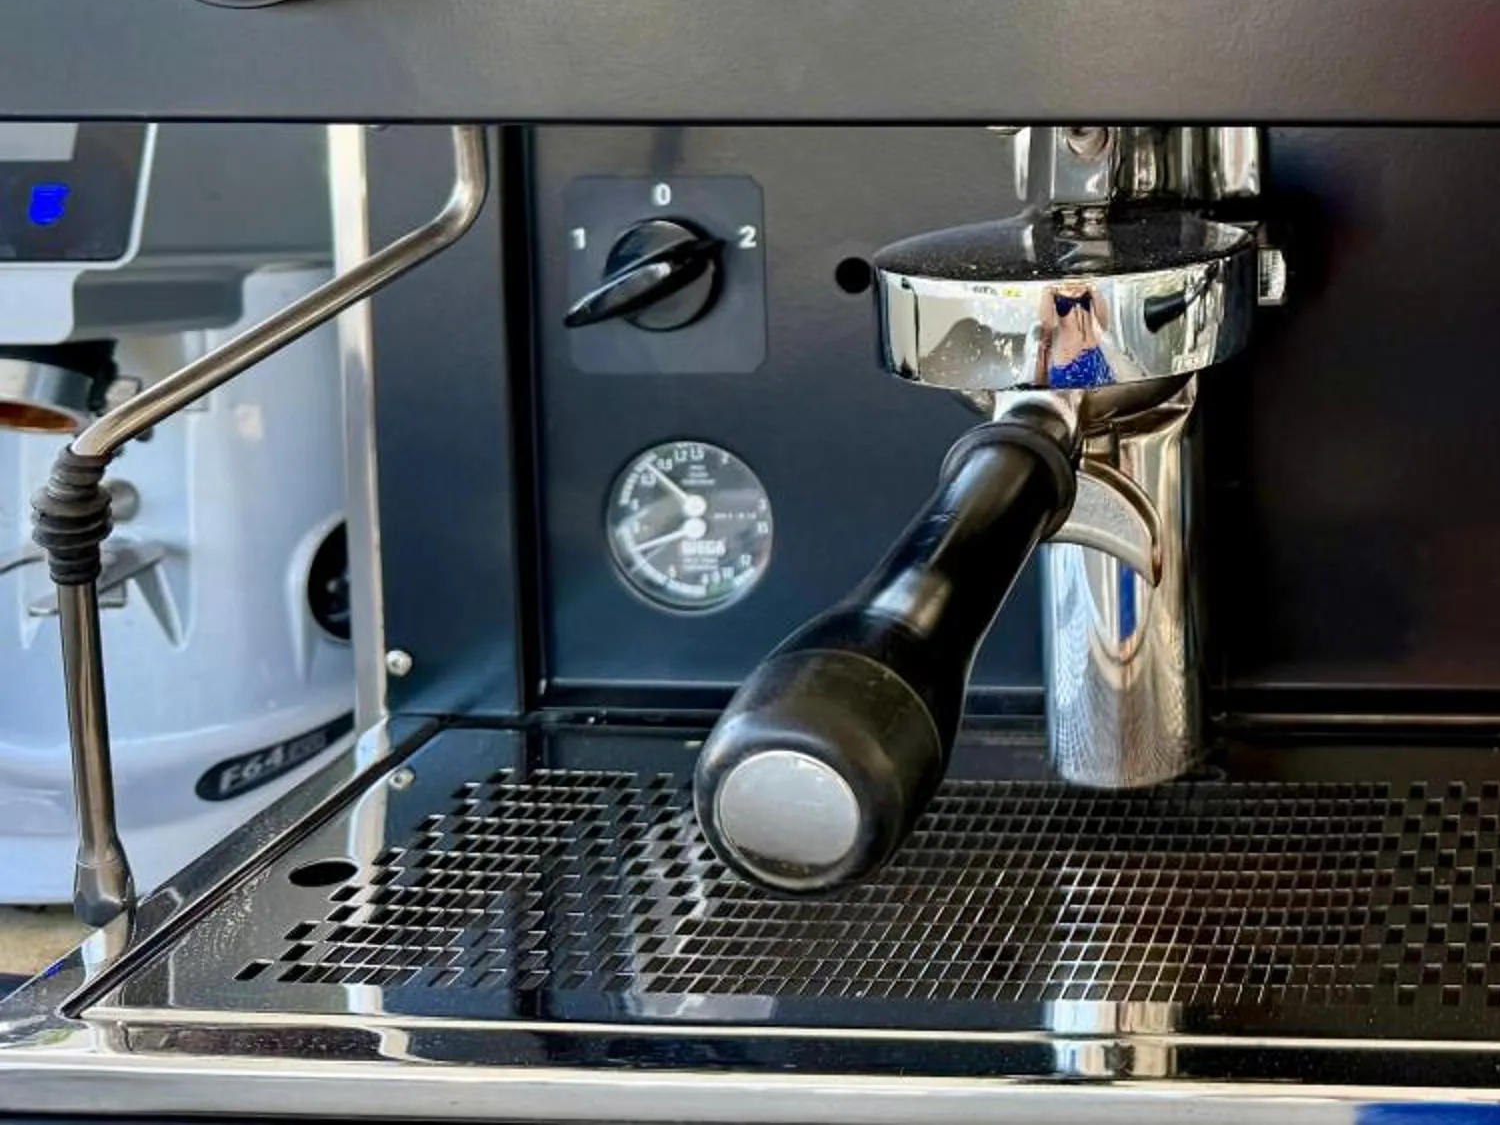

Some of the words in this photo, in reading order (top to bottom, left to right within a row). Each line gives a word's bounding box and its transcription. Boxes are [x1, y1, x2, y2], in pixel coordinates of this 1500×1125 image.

[654, 183, 672, 206] 0
[571, 227, 587, 250] 1
[737, 225, 757, 249] 2
